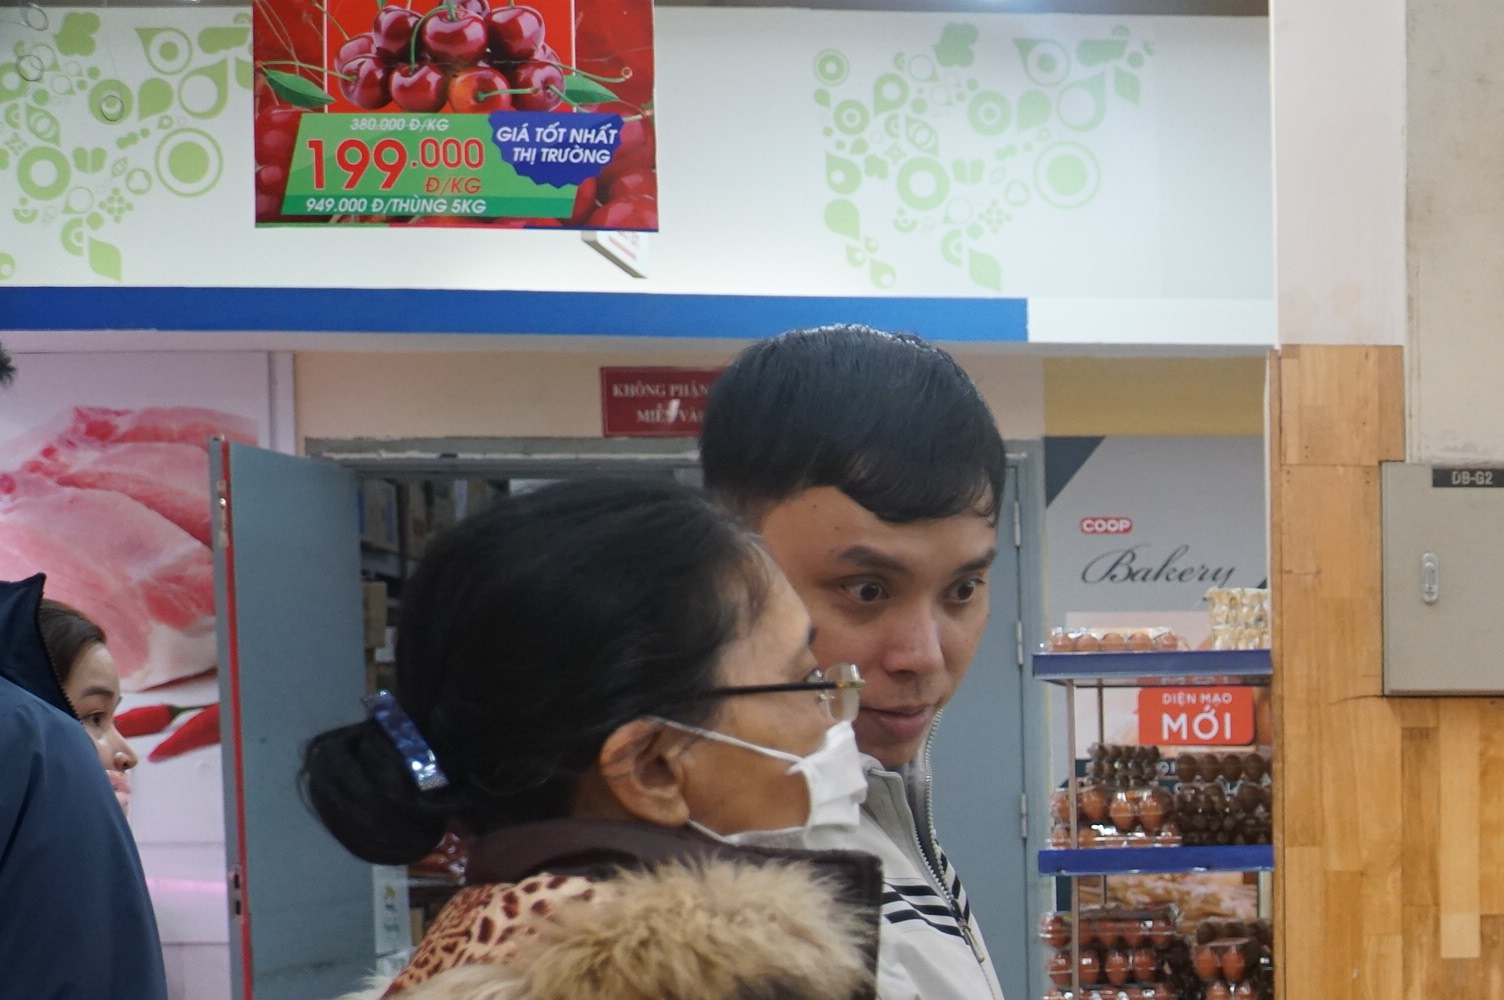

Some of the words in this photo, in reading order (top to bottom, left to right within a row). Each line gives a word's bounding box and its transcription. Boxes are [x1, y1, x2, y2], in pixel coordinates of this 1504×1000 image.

[496, 122, 530, 142] GIÁ
[535, 121, 567, 143] TỐT
[569, 122, 618, 144] NHẤT
[307, 137, 485, 190] 199.000
[513, 147, 537, 165] THỊ
[540, 144, 611, 164] TRƯỜNG
[424, 176, 482, 195] Đ/KG
[305, 197, 367, 213] 949.000
[371, 194, 447, 214] Đ/THÙNG
[451, 199, 487, 213] 5KG
[1451, 471, 1493, 486] DB-G2
[1083, 519, 1132, 533] COOP
[1081, 544, 1235, 586] Bakery
[1162, 691, 1197, 706] DIỆN
[1200, 692, 1233, 707] MẠO
[1162, 704, 1232, 740] MỚI
